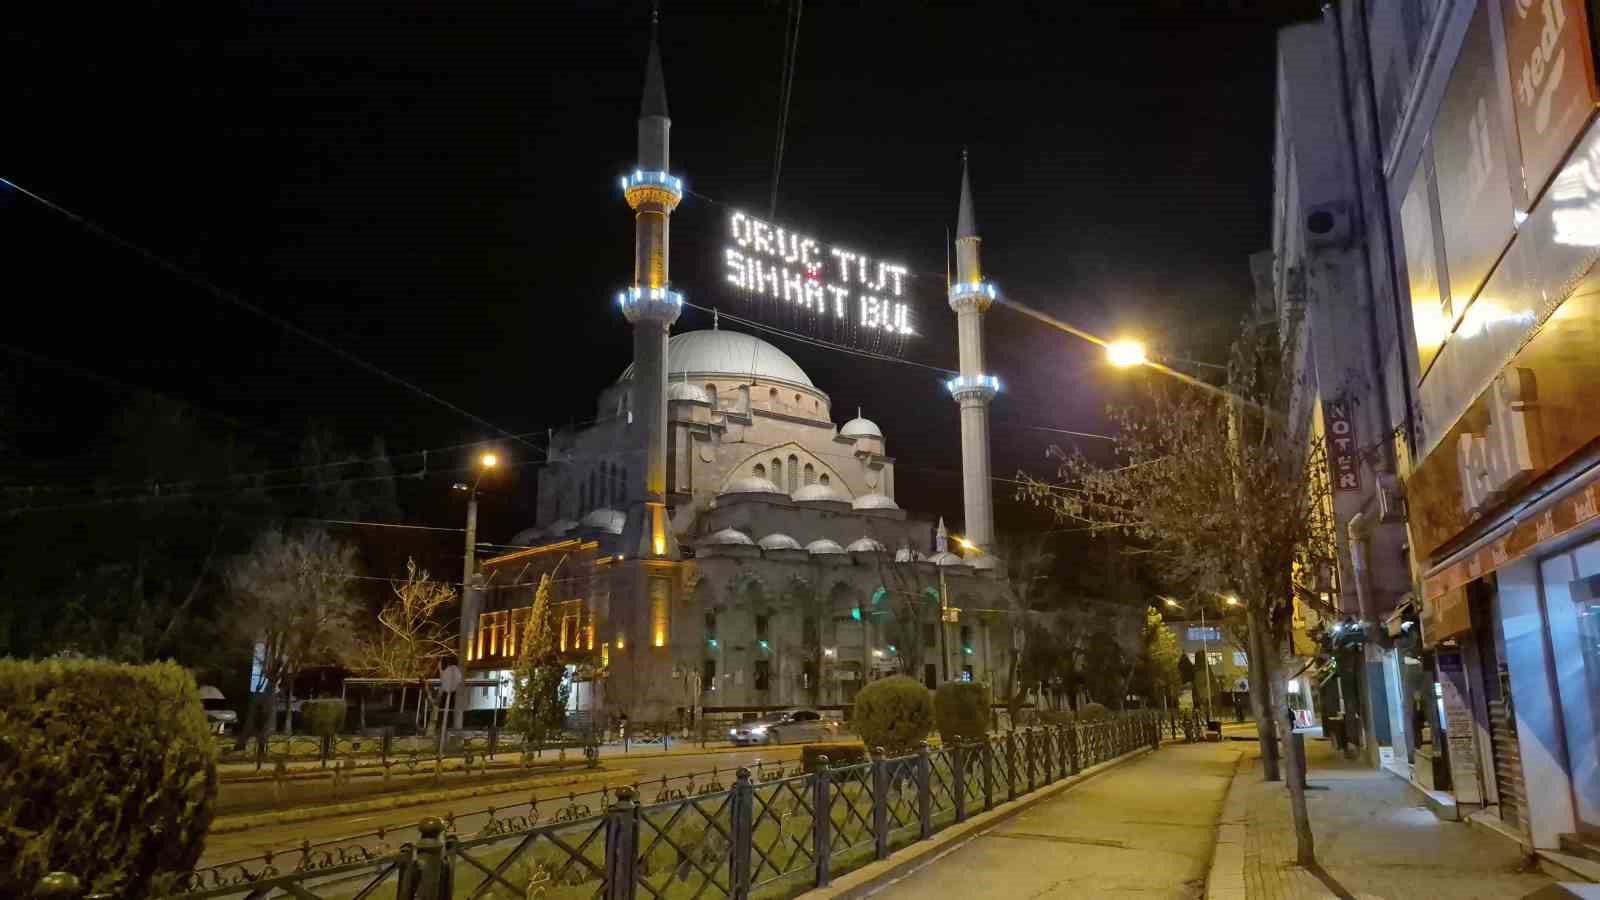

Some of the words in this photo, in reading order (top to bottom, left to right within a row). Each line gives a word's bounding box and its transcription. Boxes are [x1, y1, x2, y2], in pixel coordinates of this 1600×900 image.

[726, 248, 849, 318] SIHHAT
[860, 295, 913, 334] BUL
[832, 247, 907, 296] TUT
[1329, 402, 1358, 488] NOTER
